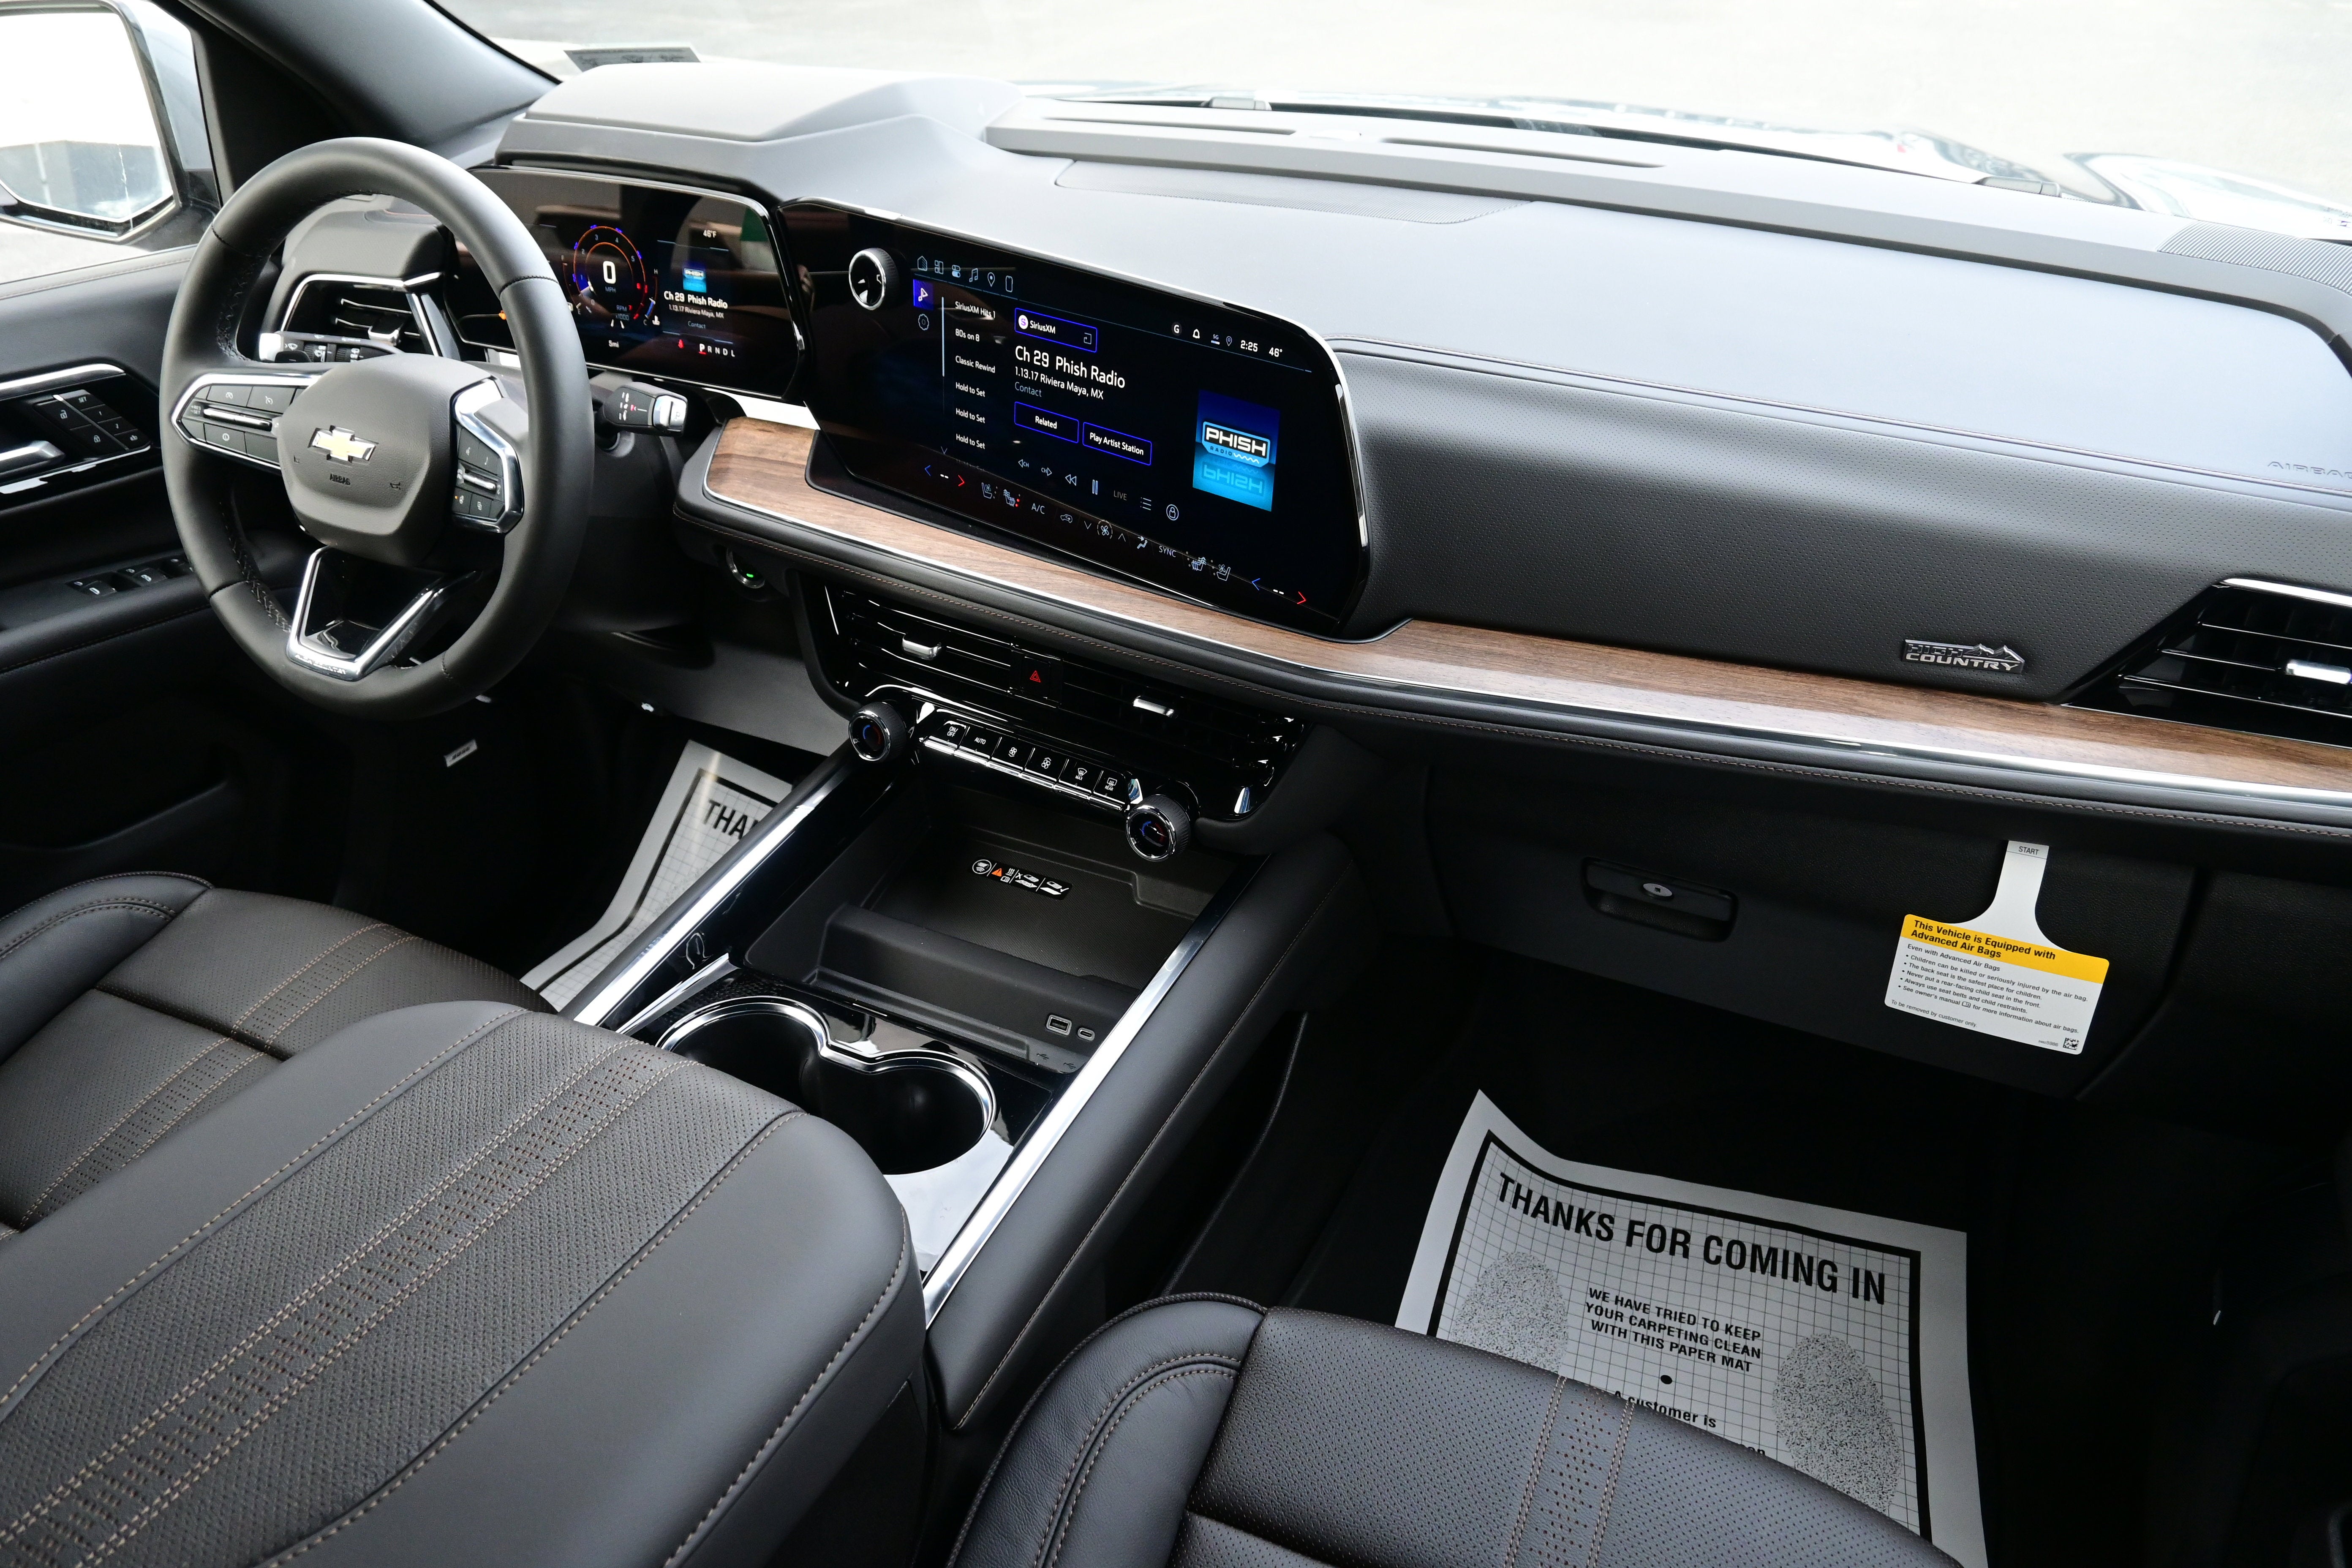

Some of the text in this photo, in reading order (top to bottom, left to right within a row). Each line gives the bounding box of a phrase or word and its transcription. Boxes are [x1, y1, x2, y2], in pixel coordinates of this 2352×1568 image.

[603, 261, 616, 284] 0
[664, 291, 728, 309] Ch 29 Phish Radio
[955, 301, 979, 314] SiriusXM
[980, 306, 991, 317] Hits
[685, 306, 701, 315] Riviera
[688, 321, 706, 329] Contact
[1030, 320, 1056, 334] SiriusXM
[955, 328, 966, 338] 80s
[975, 334, 980, 342] 8
[700, 343, 705, 352] P
[731, 349, 735, 357] L
[1240, 340, 1258, 352] 2:25
[955, 355, 996, 373] Classic Rewind
[1015, 346, 1125, 388] Ch 29 Phish Radio
[956, 381, 985, 397] Hold to Set
[1015, 366, 1104, 400] 1.13.17 Riviera Maya, MX
[1015, 381, 1042, 397] Contact
[956, 408, 985, 424] Hold to Set
[1035, 416, 1057, 429] Related
[1090, 432, 1144, 455] Play Artist Station
[1206, 427, 1266, 457] PHISH
[1210, 446, 1232, 456] RADIO
[330, 474, 351, 485] AIRBAG
[1113, 490, 1127, 501] LIVE
[1031, 503, 1045, 514] A/C
[1159, 545, 1176, 558] SYNC
[1908, 644, 1963, 657] HIGH
[1906, 653, 2020, 671] COUNTRY
[2018, 846, 2040, 855] START
[1911, 930, 2002, 958] Advanced Air Bags
[1914, 920, 2056, 960] This Vehicle is Equipped with
[1908, 944, 1922, 952] Even
[1940, 953, 1972, 964] Advanced
[1984, 963, 2001, 972] Bags
[1911, 955, 1936, 966] Children
[1960, 968, 1977, 976] killed
[1987, 975, 2016, 986] seriously
[2017, 981, 2040, 991] injured
[1905, 978, 1925, 988] Always
[1952, 991, 1967, 999] belts
[1997, 1003, 2028, 1013] restraints.
[1907, 970, 1924, 979] Never
[1941, 980, 1974, 993] rear-facing
[2025, 1000, 2041, 1008] front.
[1968, 978, 1987, 987] safest
[2016, 990, 2042, 1000] children.
[1906, 1005, 1930, 1015] removed
[1938, 1014, 1964, 1024] customer
[1915, 990, 1938, 999] owner's
[1939, 996, 1960, 1005] manual
[1999, 1011, 2033, 1023] information
[1499, 1172, 1885, 1305] THANKS FOR COMING IN
[1589, 1288, 1761, 1341] WE HAVE TRIED TO KEEP
[1586, 1302, 1761, 1359] YOUR CARPETING CLEAN
[1592, 1320, 1753, 1372] WITH THIS PAPER MAT
[1704, 1415, 1717, 1428] is
